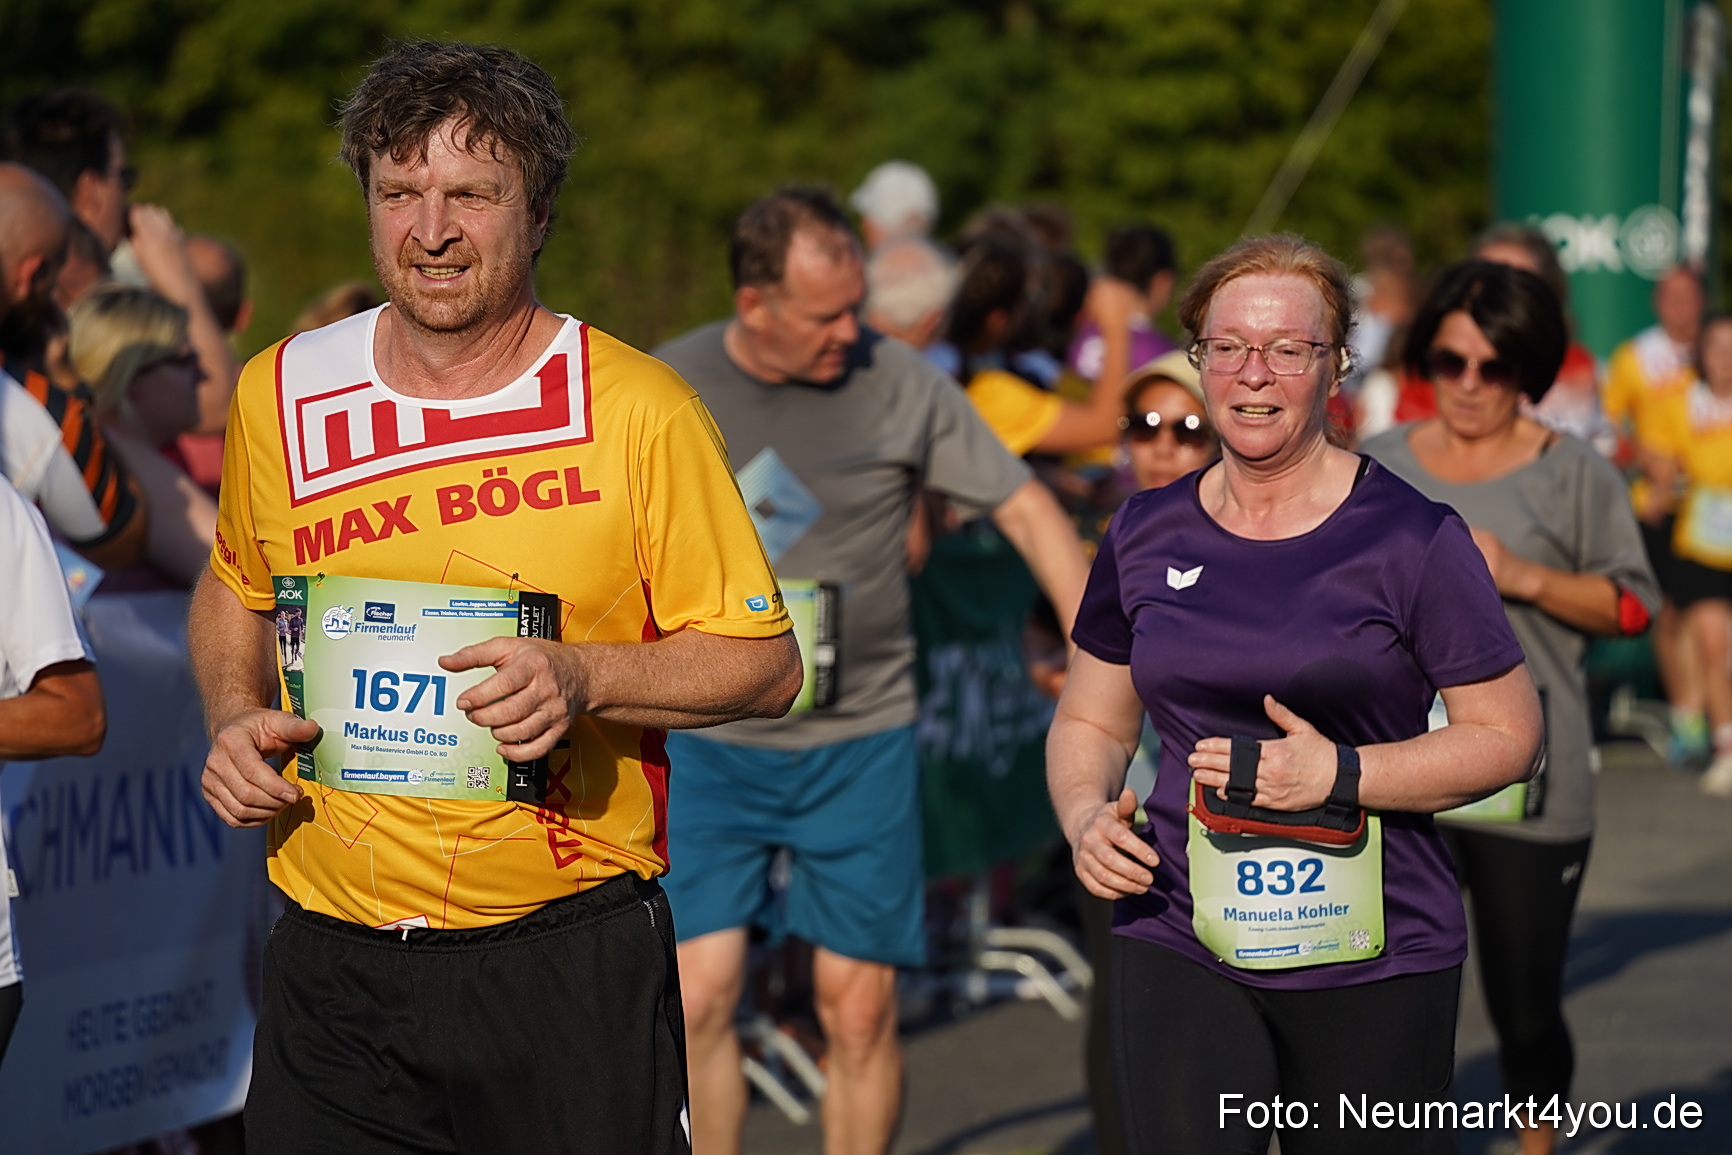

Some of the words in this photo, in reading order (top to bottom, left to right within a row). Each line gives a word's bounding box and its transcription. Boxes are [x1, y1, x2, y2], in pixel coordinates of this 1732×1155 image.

[1540, 212, 1625, 275] OK
[293, 494, 419, 566] MAX
[436, 466, 601, 526] BÖGL
[277, 589, 304, 601] AOK
[353, 622, 418, 634] Firmenlauf
[520, 603, 530, 639] BATT
[352, 668, 448, 716] 1671
[343, 721, 409, 743] Markus
[413, 727, 459, 747] Goss
[362, 744, 375, 753] Bögl
[375, 746, 406, 754] Bauservice
[343, 771, 405, 782] firmenlauf.bayern
[1236, 857, 1326, 896] 832
[1223, 907, 1294, 922] Manuela
[1298, 902, 1350, 919] Kohler
